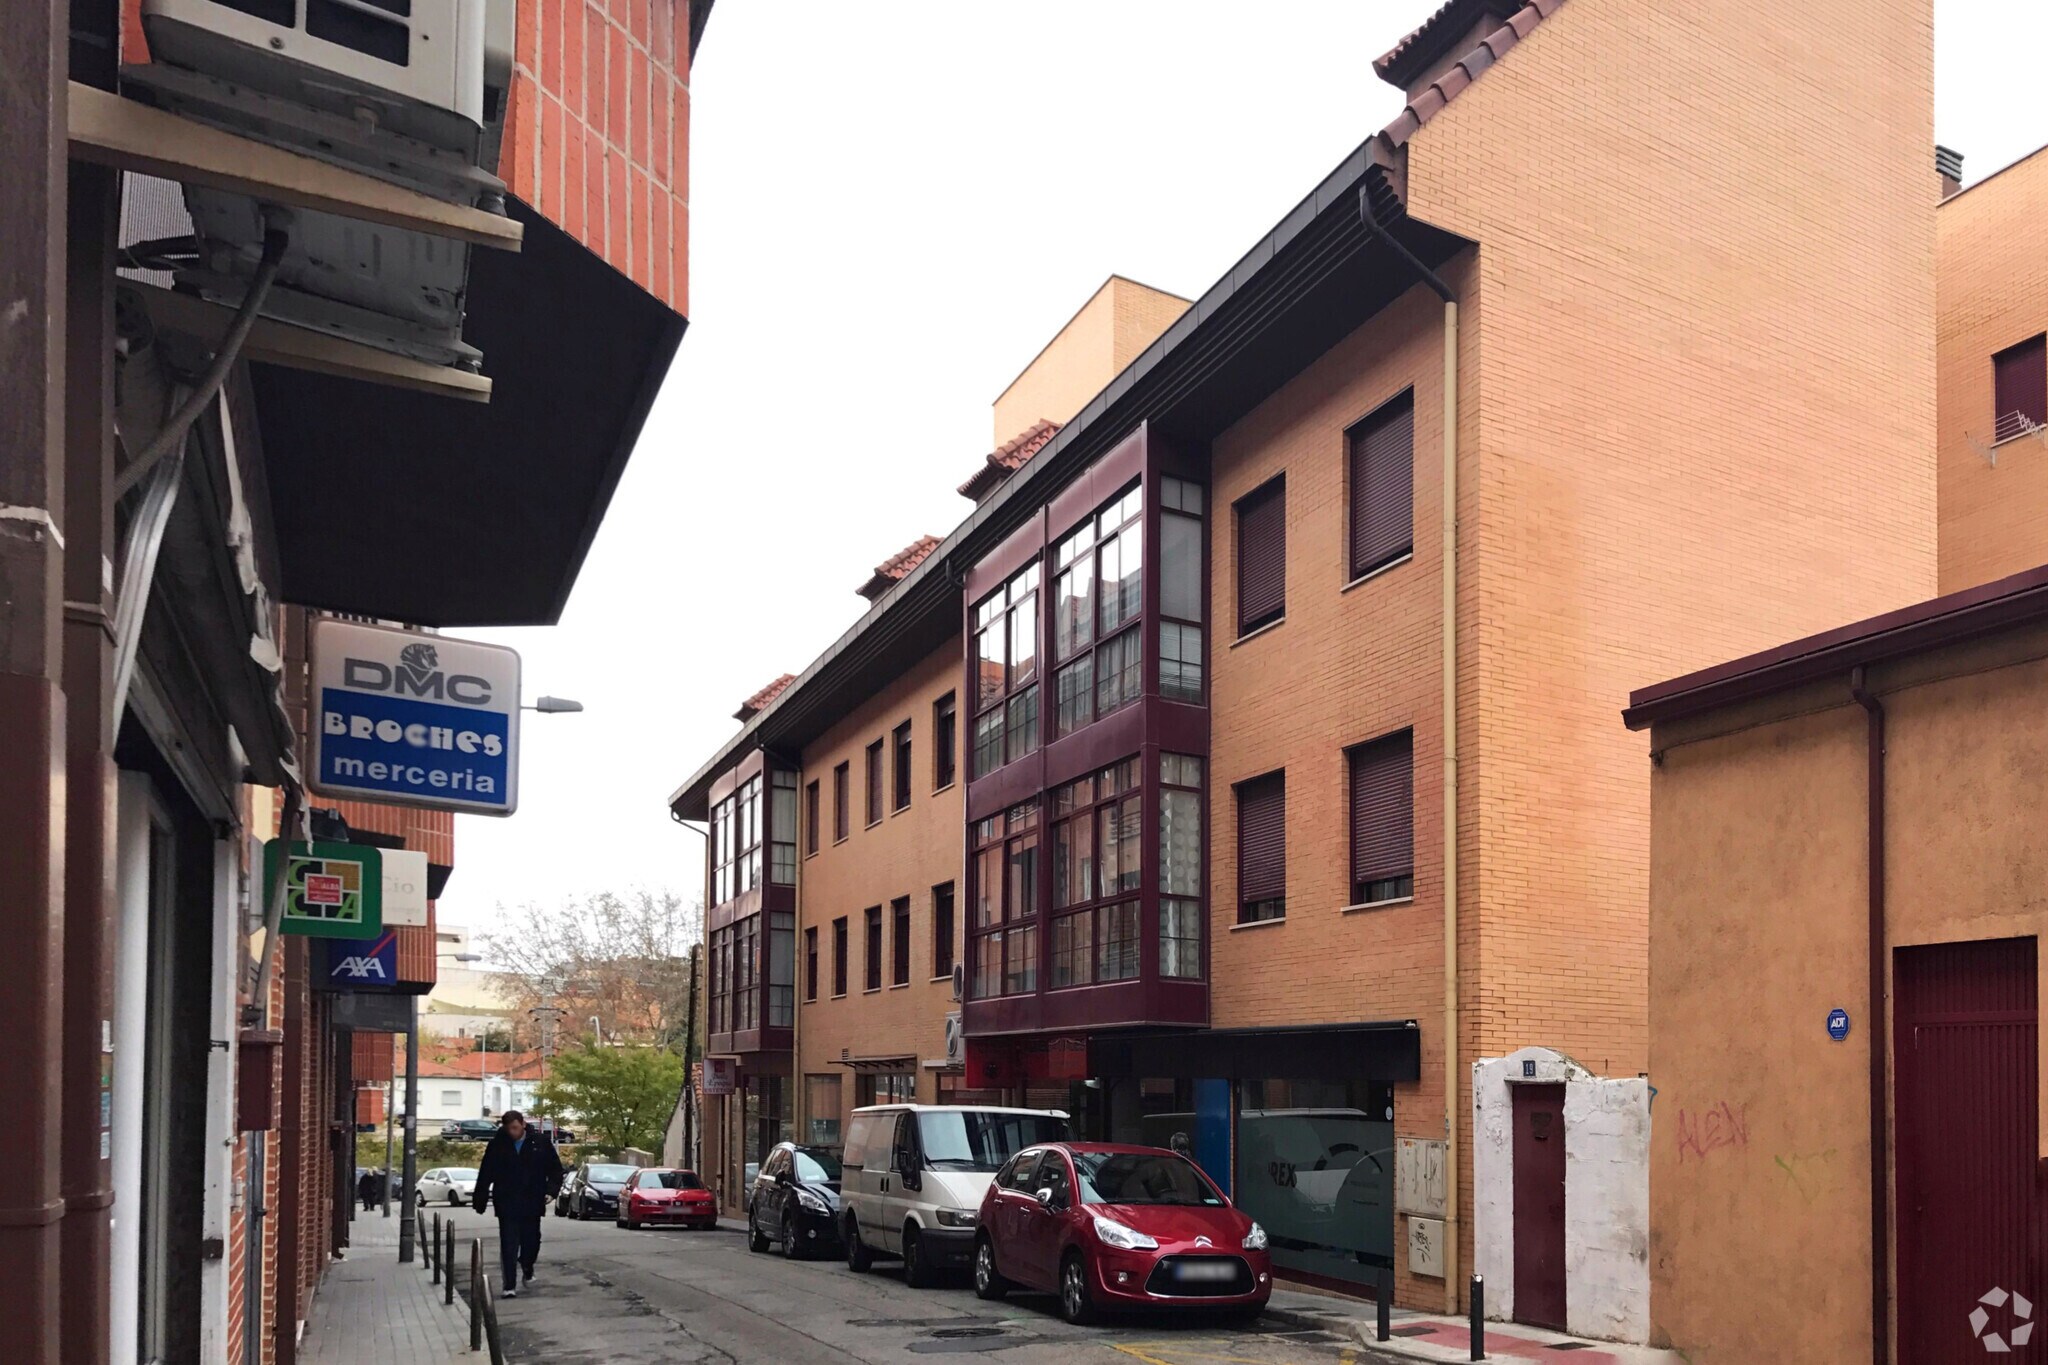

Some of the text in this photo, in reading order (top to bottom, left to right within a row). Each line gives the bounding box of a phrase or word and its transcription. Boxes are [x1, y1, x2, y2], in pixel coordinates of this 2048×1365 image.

[344, 657, 491, 705] DMC
[334, 756, 495, 794] merceria
[331, 956, 386, 978] AXA
[1830, 1017, 1846, 1029] ADT
[1525, 1063, 1534, 1075] 19
